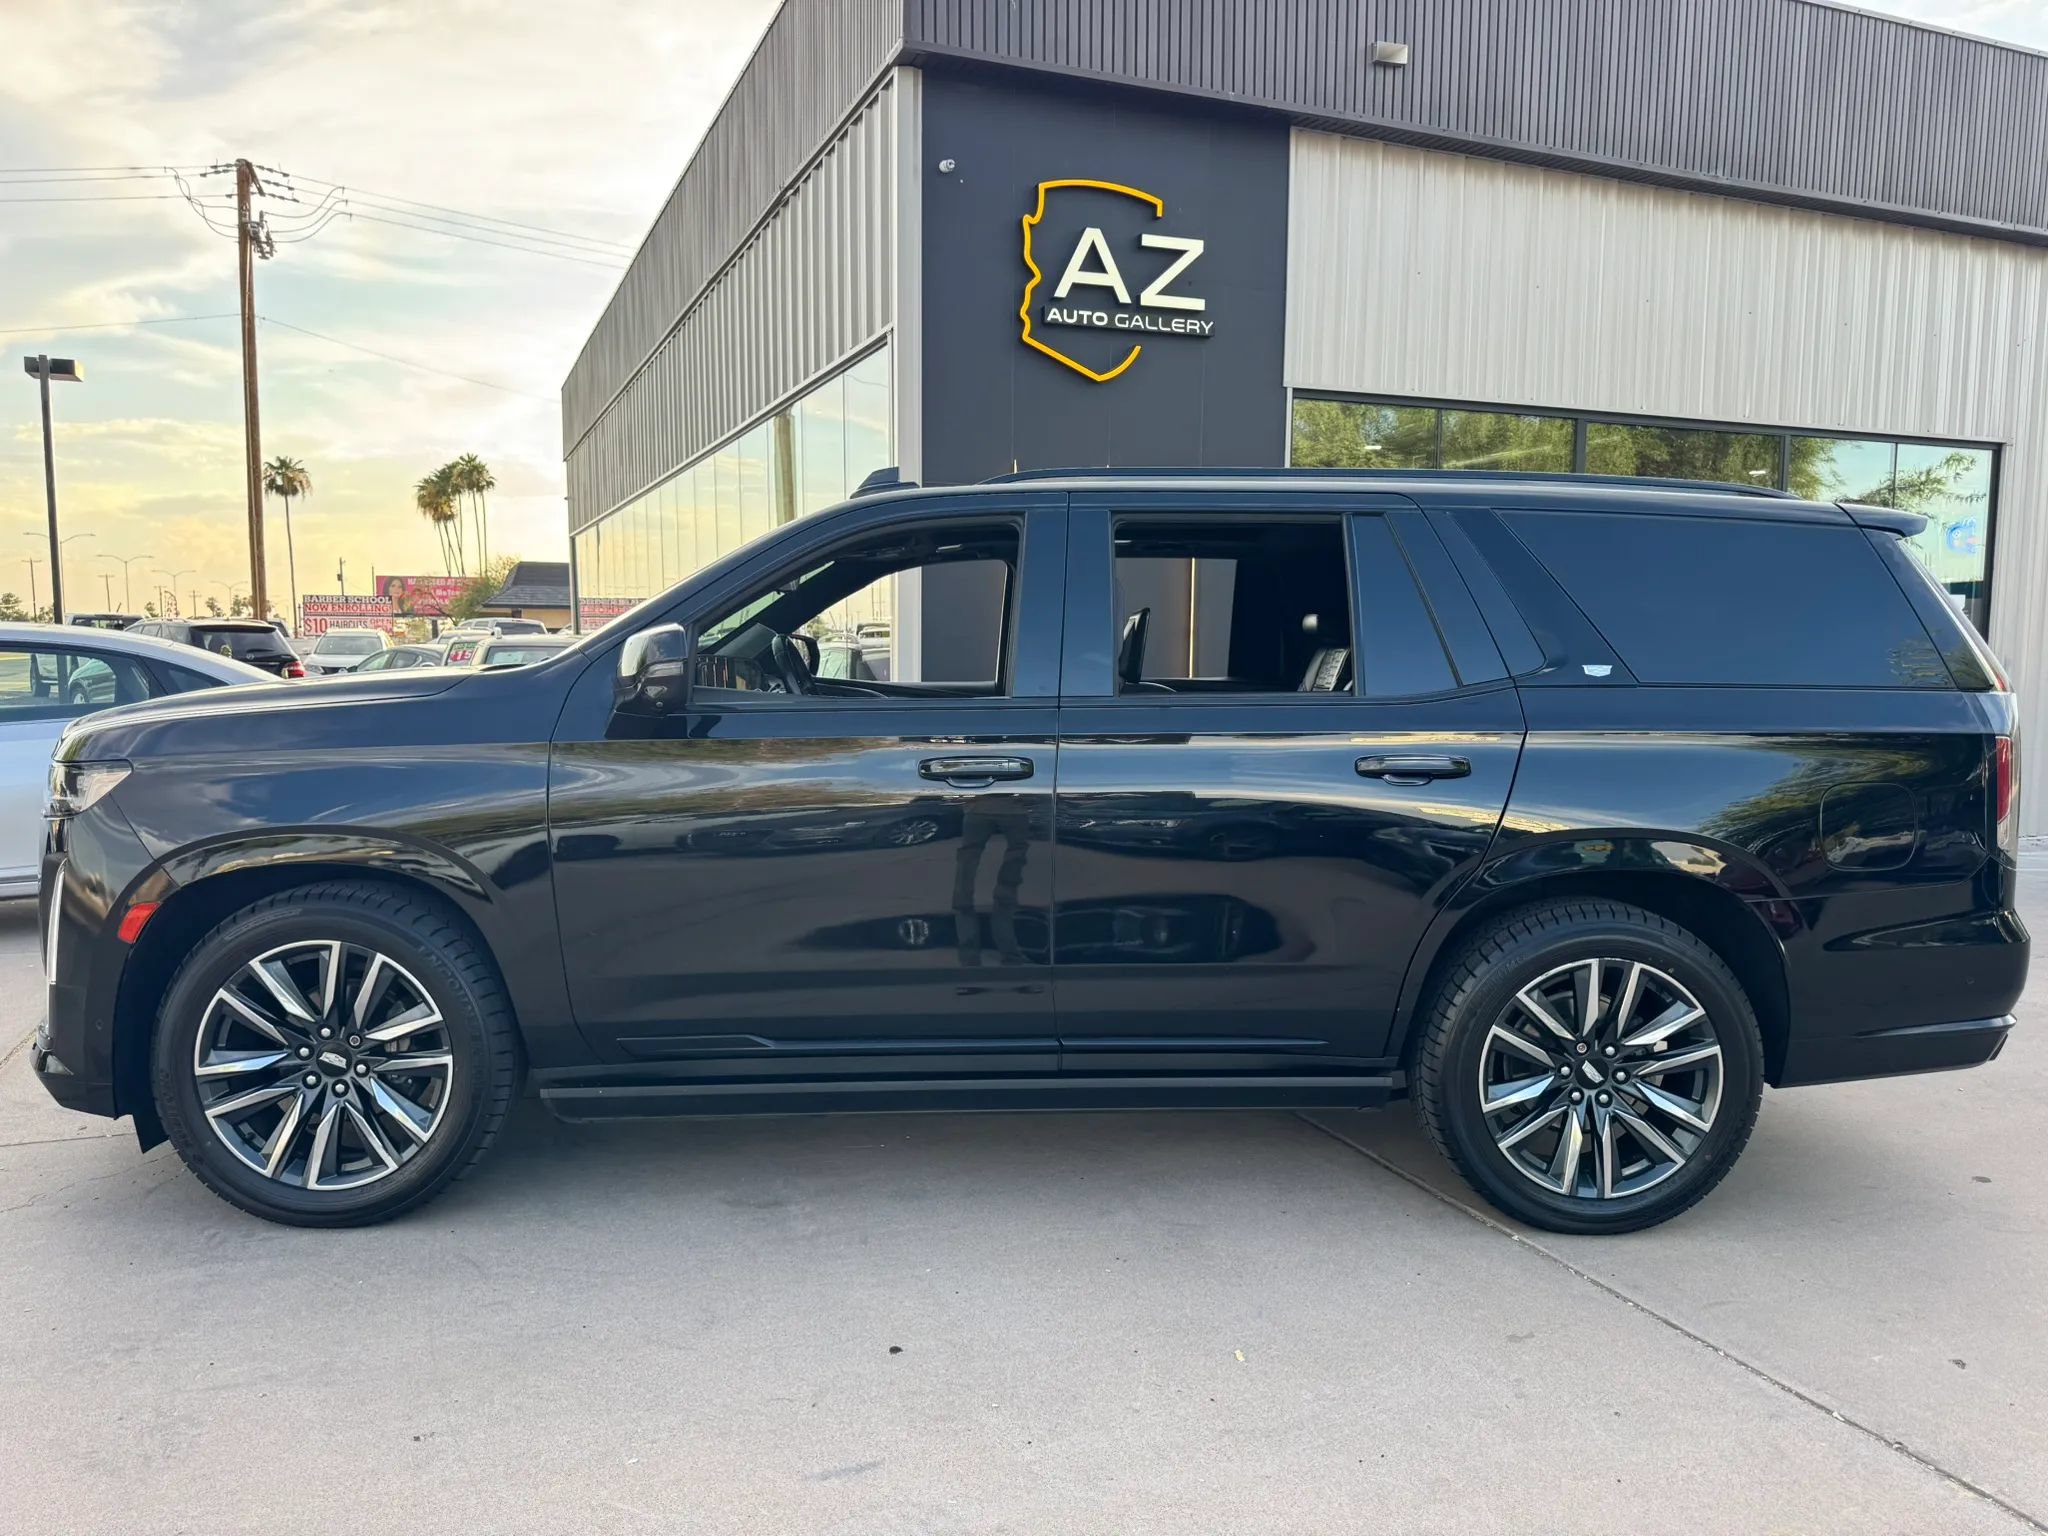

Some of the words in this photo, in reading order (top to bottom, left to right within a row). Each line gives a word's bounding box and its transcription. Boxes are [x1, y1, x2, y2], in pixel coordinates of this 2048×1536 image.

[1053, 226, 1206, 311] AZ
[1046, 307, 1109, 327] AUTO
[1114, 313, 1215, 334] GALLERY
[304, 604, 329, 612] NOW
[347, 596, 392, 604] SCHOOL
[304, 617, 328, 633] $10
[329, 620, 369, 629] HAIRCUTS
